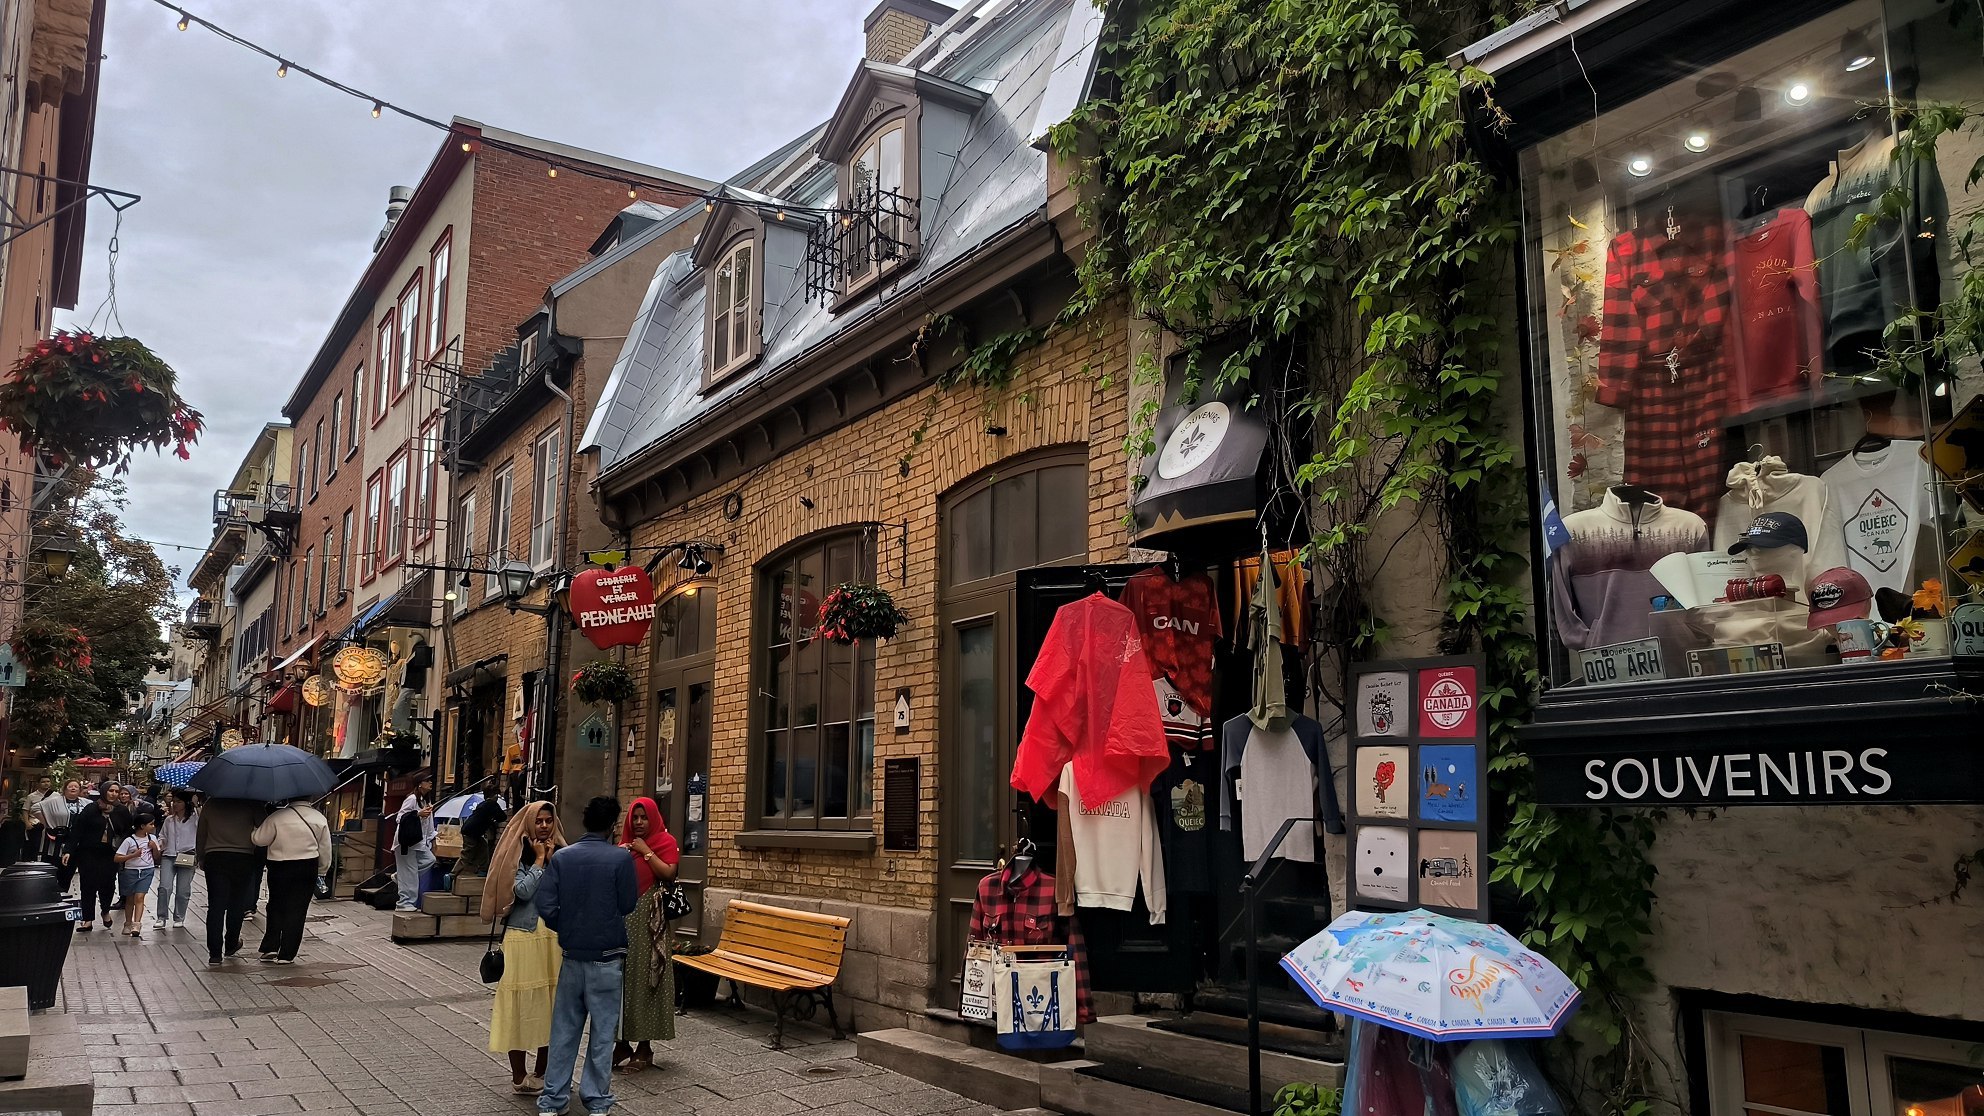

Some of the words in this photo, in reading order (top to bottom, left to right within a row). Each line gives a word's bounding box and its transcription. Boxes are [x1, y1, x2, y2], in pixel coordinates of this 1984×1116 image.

[1180, 411, 1221, 435] SOUVENIRS
[612, 585, 624, 595] ET
[600, 592, 639, 604] VERGER
[580, 604, 656, 628] PEDNEAULT
[1153, 615, 1200, 636] CAN
[1627, 649, 1661, 677] ARH
[1425, 696, 1469, 711] CANADA
[1584, 747, 1892, 800] SOUVENIRS
[1344, 994, 1363, 1006] CANADA
[1380, 1004, 1400, 1017] CANADA
[1416, 1015, 1437, 1027] CANADA
[1451, 1018, 1471, 1027] CANADA
[1486, 1017, 1506, 1026] CANADA
[1522, 1015, 1542, 1025] CANADA
